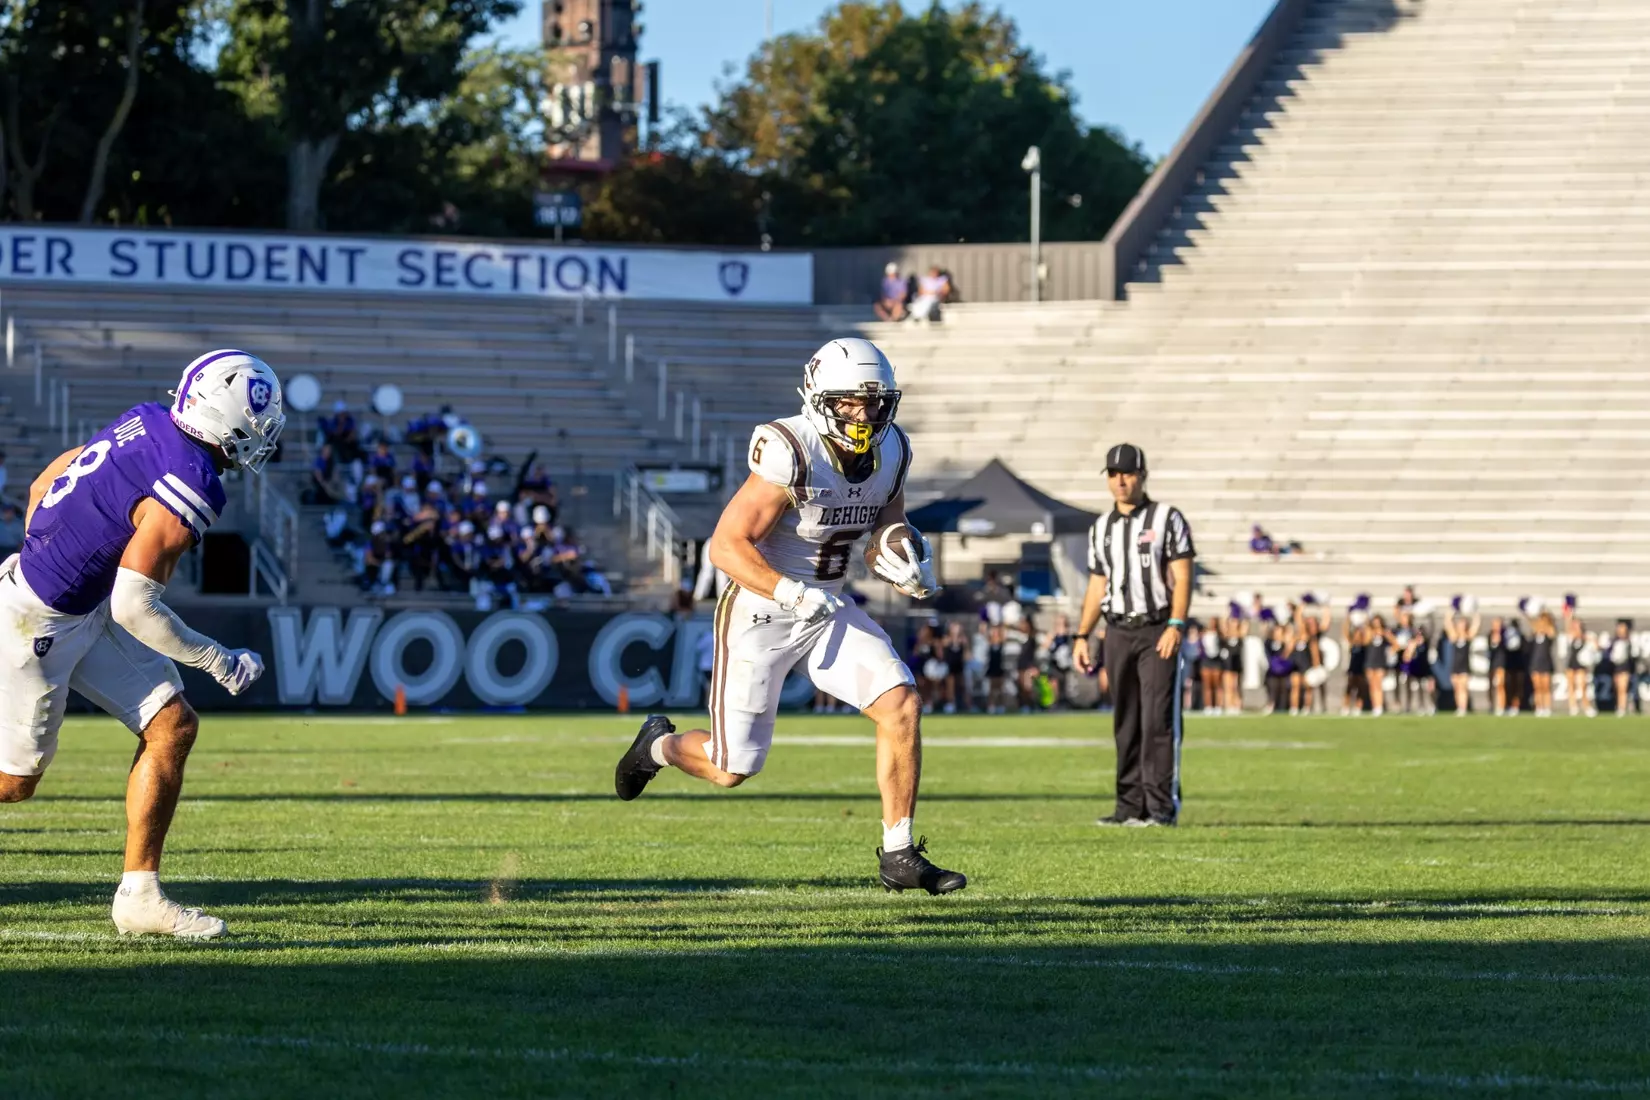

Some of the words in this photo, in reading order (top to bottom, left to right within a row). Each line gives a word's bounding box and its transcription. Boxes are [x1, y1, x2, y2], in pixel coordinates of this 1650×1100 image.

[0, 236, 75, 276] ER
[109, 237, 367, 284] STUDENT
[397, 248, 629, 293] SECTION
[195, 372, 204, 382] 8
[113, 415, 147, 448] DUE
[753, 436, 767, 464] 6
[41, 440, 112, 509] 8
[817, 504, 880, 527] LEHIGH
[815, 530, 863, 581] 6
[269, 607, 560, 705] WOO
